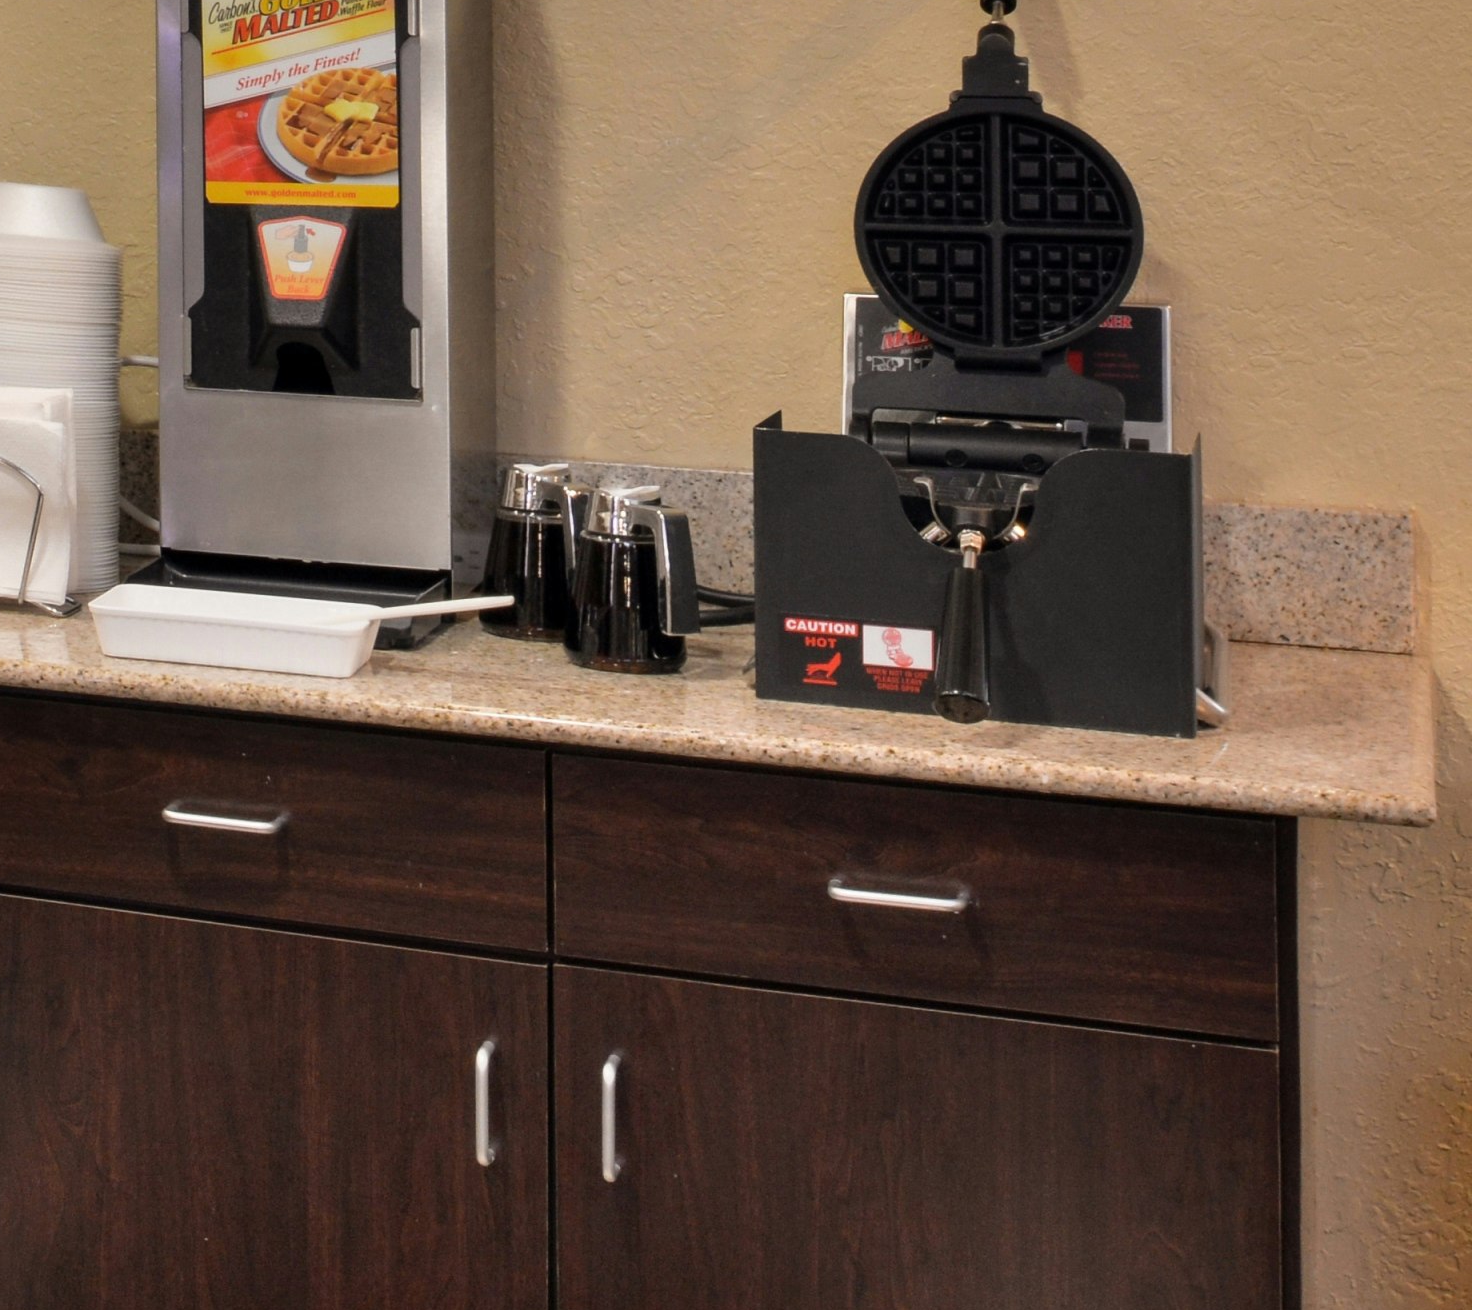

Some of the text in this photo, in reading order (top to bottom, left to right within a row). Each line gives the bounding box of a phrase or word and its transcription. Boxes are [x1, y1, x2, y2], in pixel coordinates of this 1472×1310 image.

[340, 1, 365, 15] Waffle
[232, 0, 340, 44] MALTED
[236, 48, 361, 91] Simply the Finest!
[785, 619, 856, 635] CAUTION
[804, 636, 837, 649] HOT
